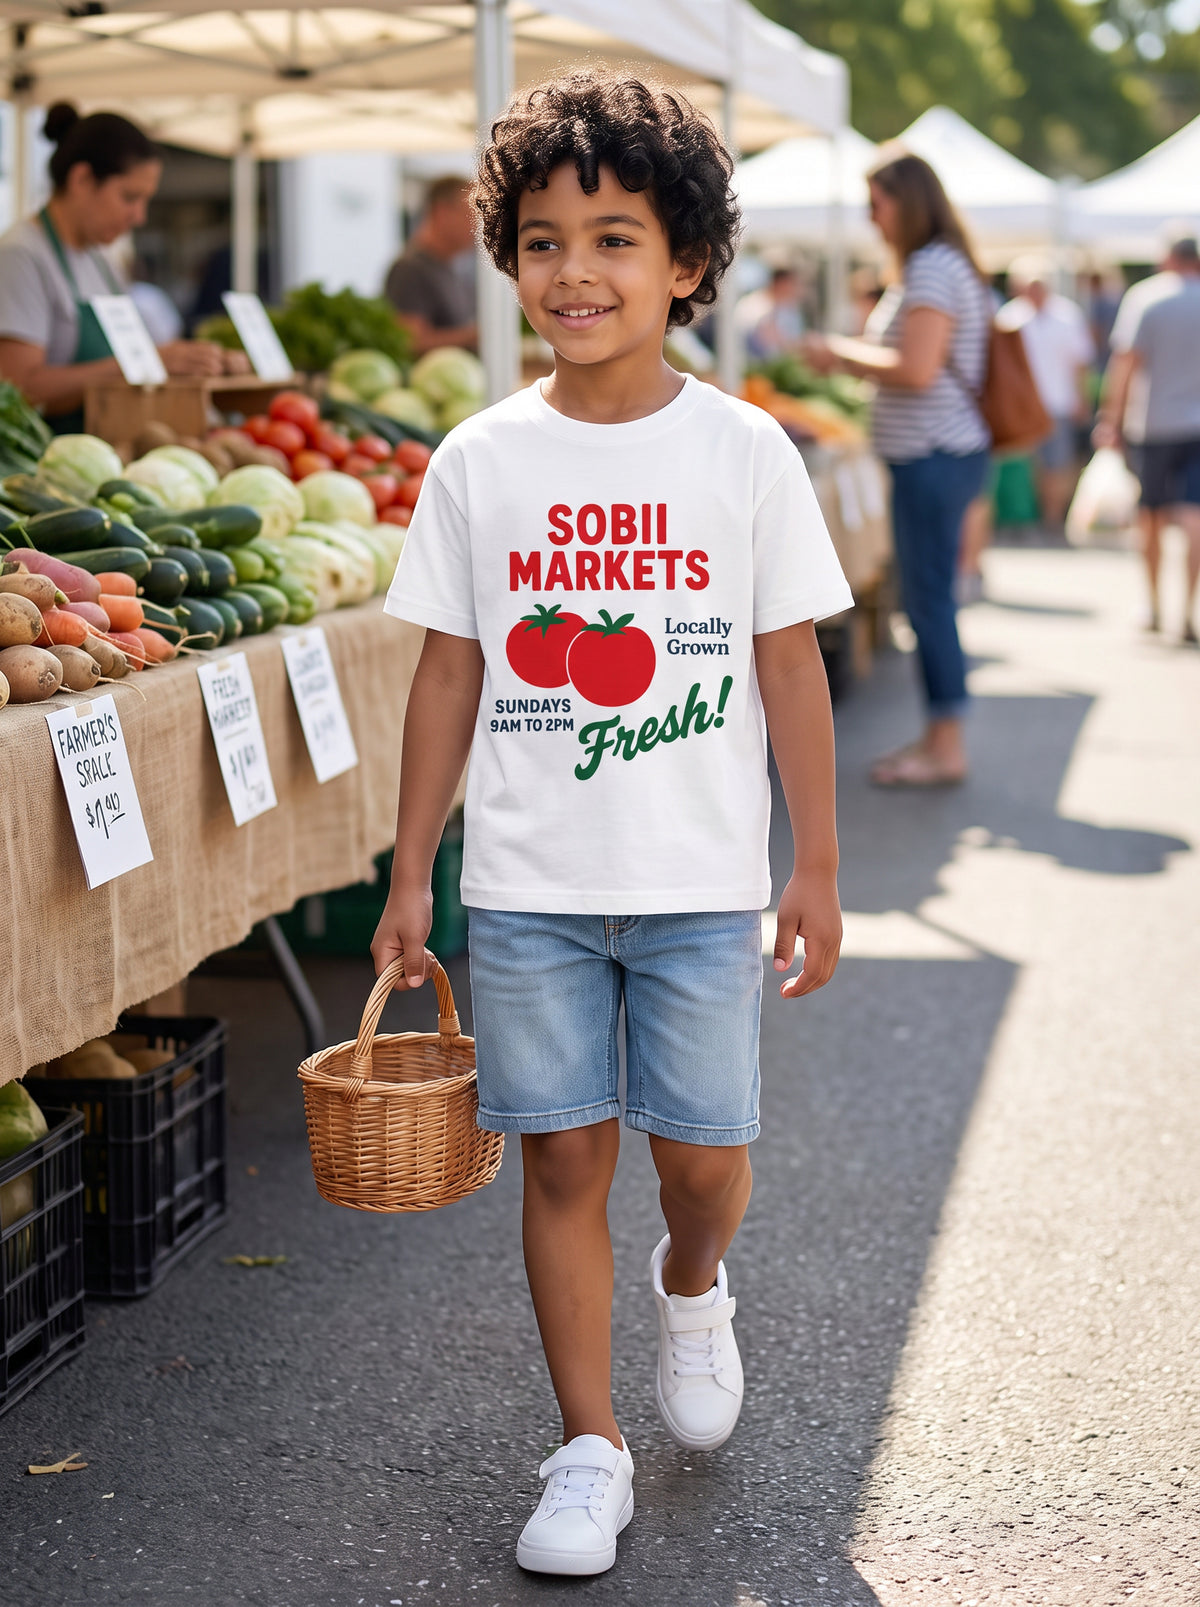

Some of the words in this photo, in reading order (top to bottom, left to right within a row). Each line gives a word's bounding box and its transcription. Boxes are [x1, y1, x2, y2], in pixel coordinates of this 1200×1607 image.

[548, 503, 667, 545] SOBII
[509, 550, 710, 591] MARKETS
[664, 617, 733, 638] Locally
[666, 638, 730, 655] Grown
[495, 698, 571, 713] SUNDAYS
[57, 712, 118, 759] FARMER'S
[490, 719, 521, 732] 9AM
[525, 718, 543, 731] TO
[545, 718, 574, 731] 2PM
[574, 675, 733, 781] Fresh!
